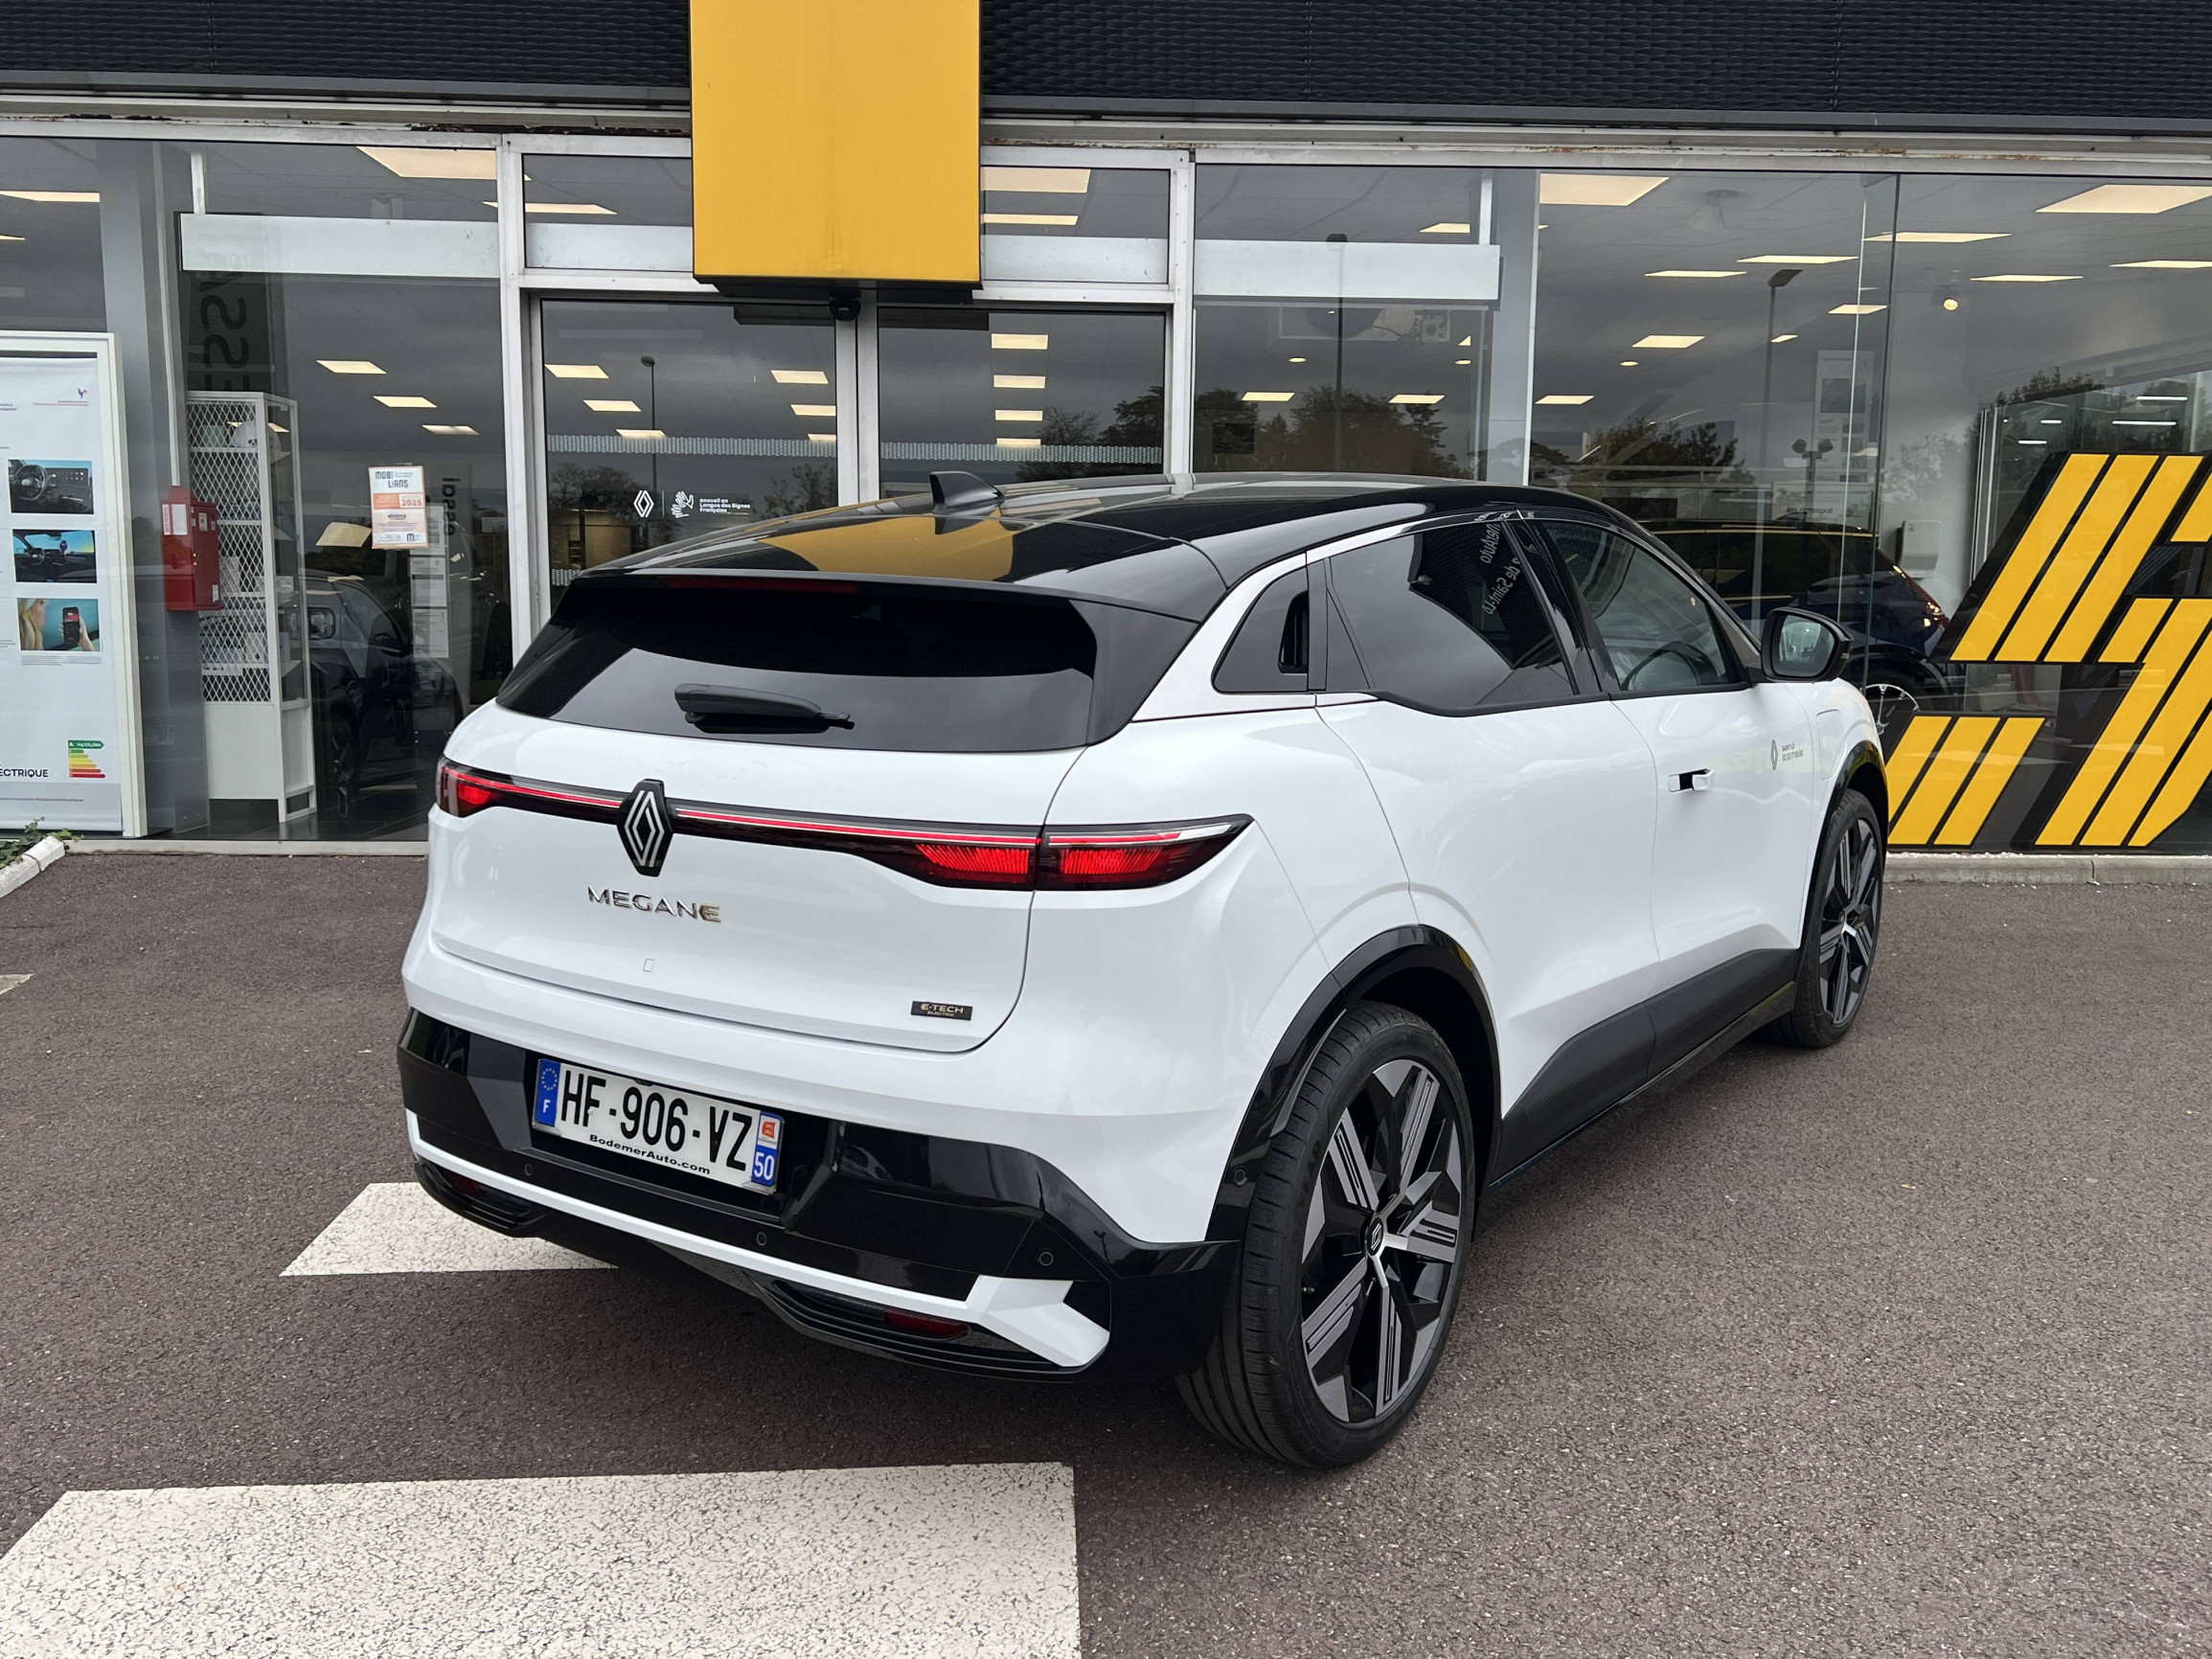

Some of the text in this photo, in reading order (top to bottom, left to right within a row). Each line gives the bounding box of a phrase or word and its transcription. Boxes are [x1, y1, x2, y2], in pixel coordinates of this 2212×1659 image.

[587, 885, 721, 923] MEGANE
[921, 1003, 965, 1014] E-TECH
[541, 1099, 551, 1113] F
[560, 1070, 753, 1172] HF-906-VZ
[589, 1134, 711, 1175] BodemerAuto.com
[753, 1151, 775, 1181] 50
